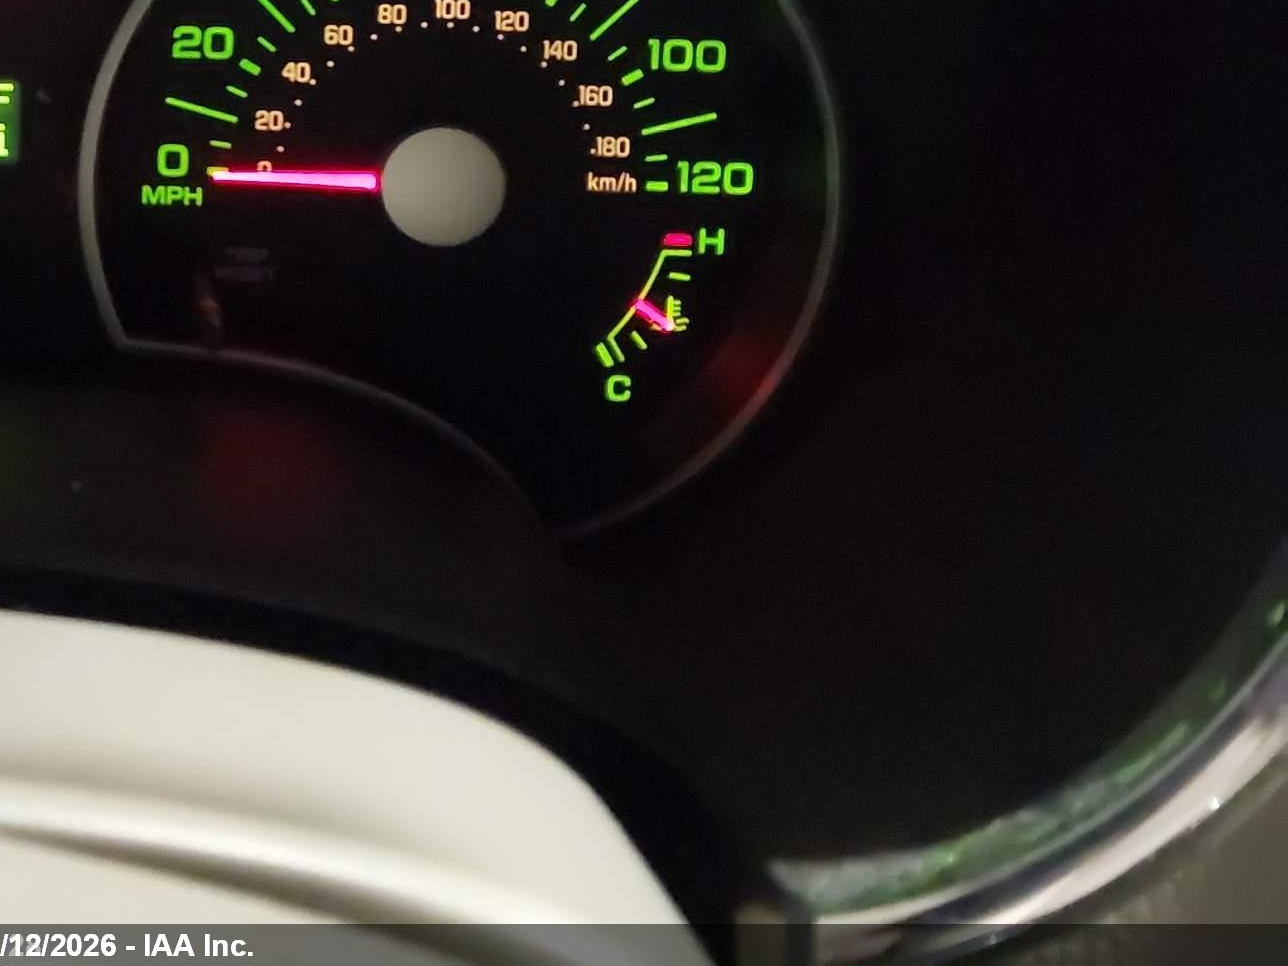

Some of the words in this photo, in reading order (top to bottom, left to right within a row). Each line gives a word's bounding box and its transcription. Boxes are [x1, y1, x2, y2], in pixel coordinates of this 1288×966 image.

[378, 4, 407, 24] 80
[435, 0, 470, 19] 100
[495, 11, 529, 31] 120
[173, 26, 233, 59] 20
[324, 25, 353, 45] 60
[544, 40, 577, 60] 140
[649, 39, 726, 72] 100
[282, 62, 309, 82] 40
[580, 85, 612, 106] 160
[255, 110, 284, 131] 20
[598, 137, 630, 157] 180
[158, 144, 188, 177] 0
[588, 172, 636, 192] km/h
[678, 161, 753, 195] 120
[142, 185, 202, 205] MPH
[699, 228, 725, 255] H
[607, 375, 631, 401] C
